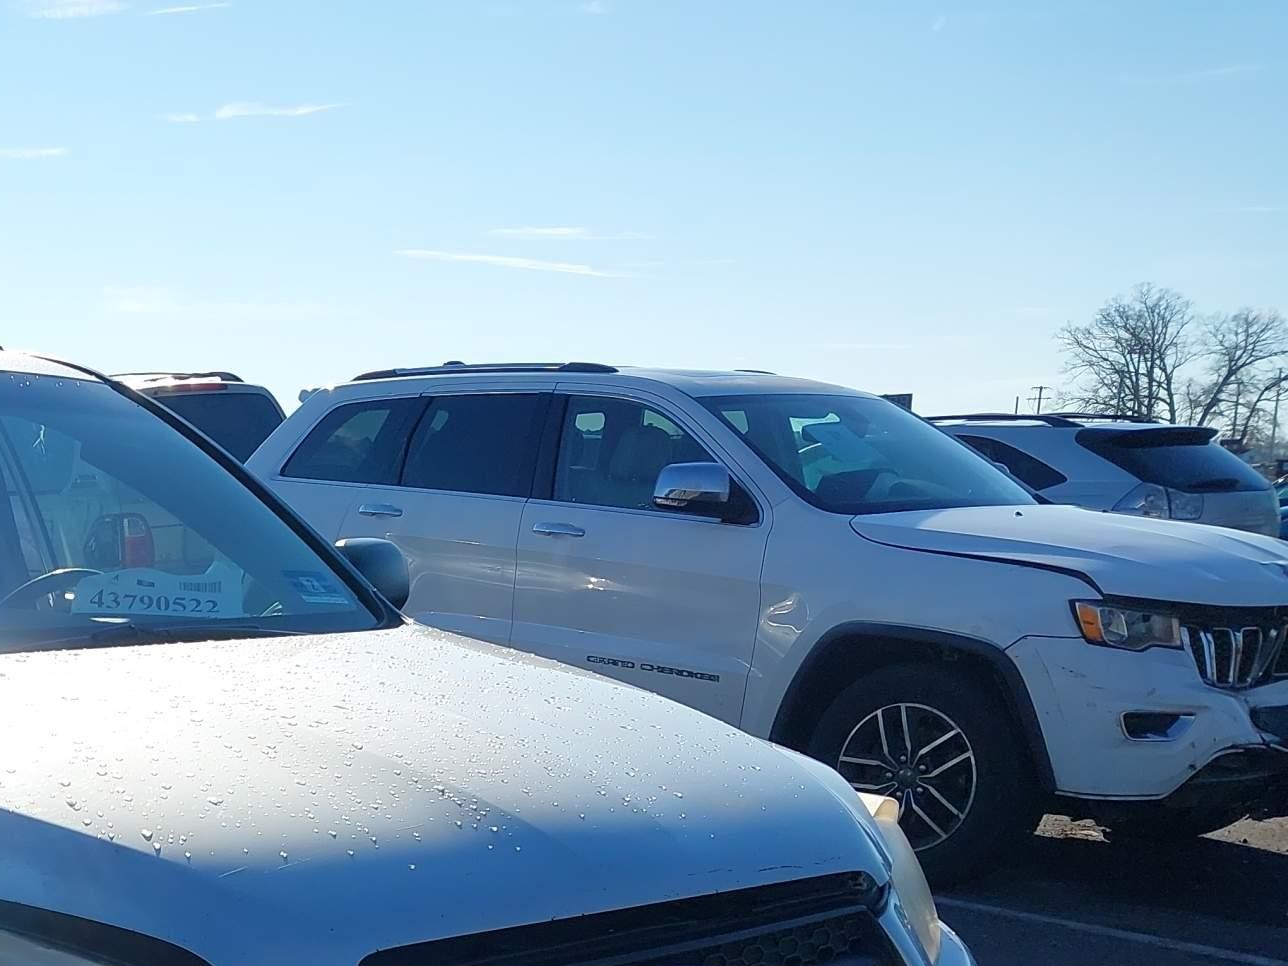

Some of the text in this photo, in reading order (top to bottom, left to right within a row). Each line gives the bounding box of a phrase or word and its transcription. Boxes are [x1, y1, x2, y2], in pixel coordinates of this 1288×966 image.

[89, 588, 220, 613] 43790522
[586, 655, 720, 683] GRAND CHEROKEE
